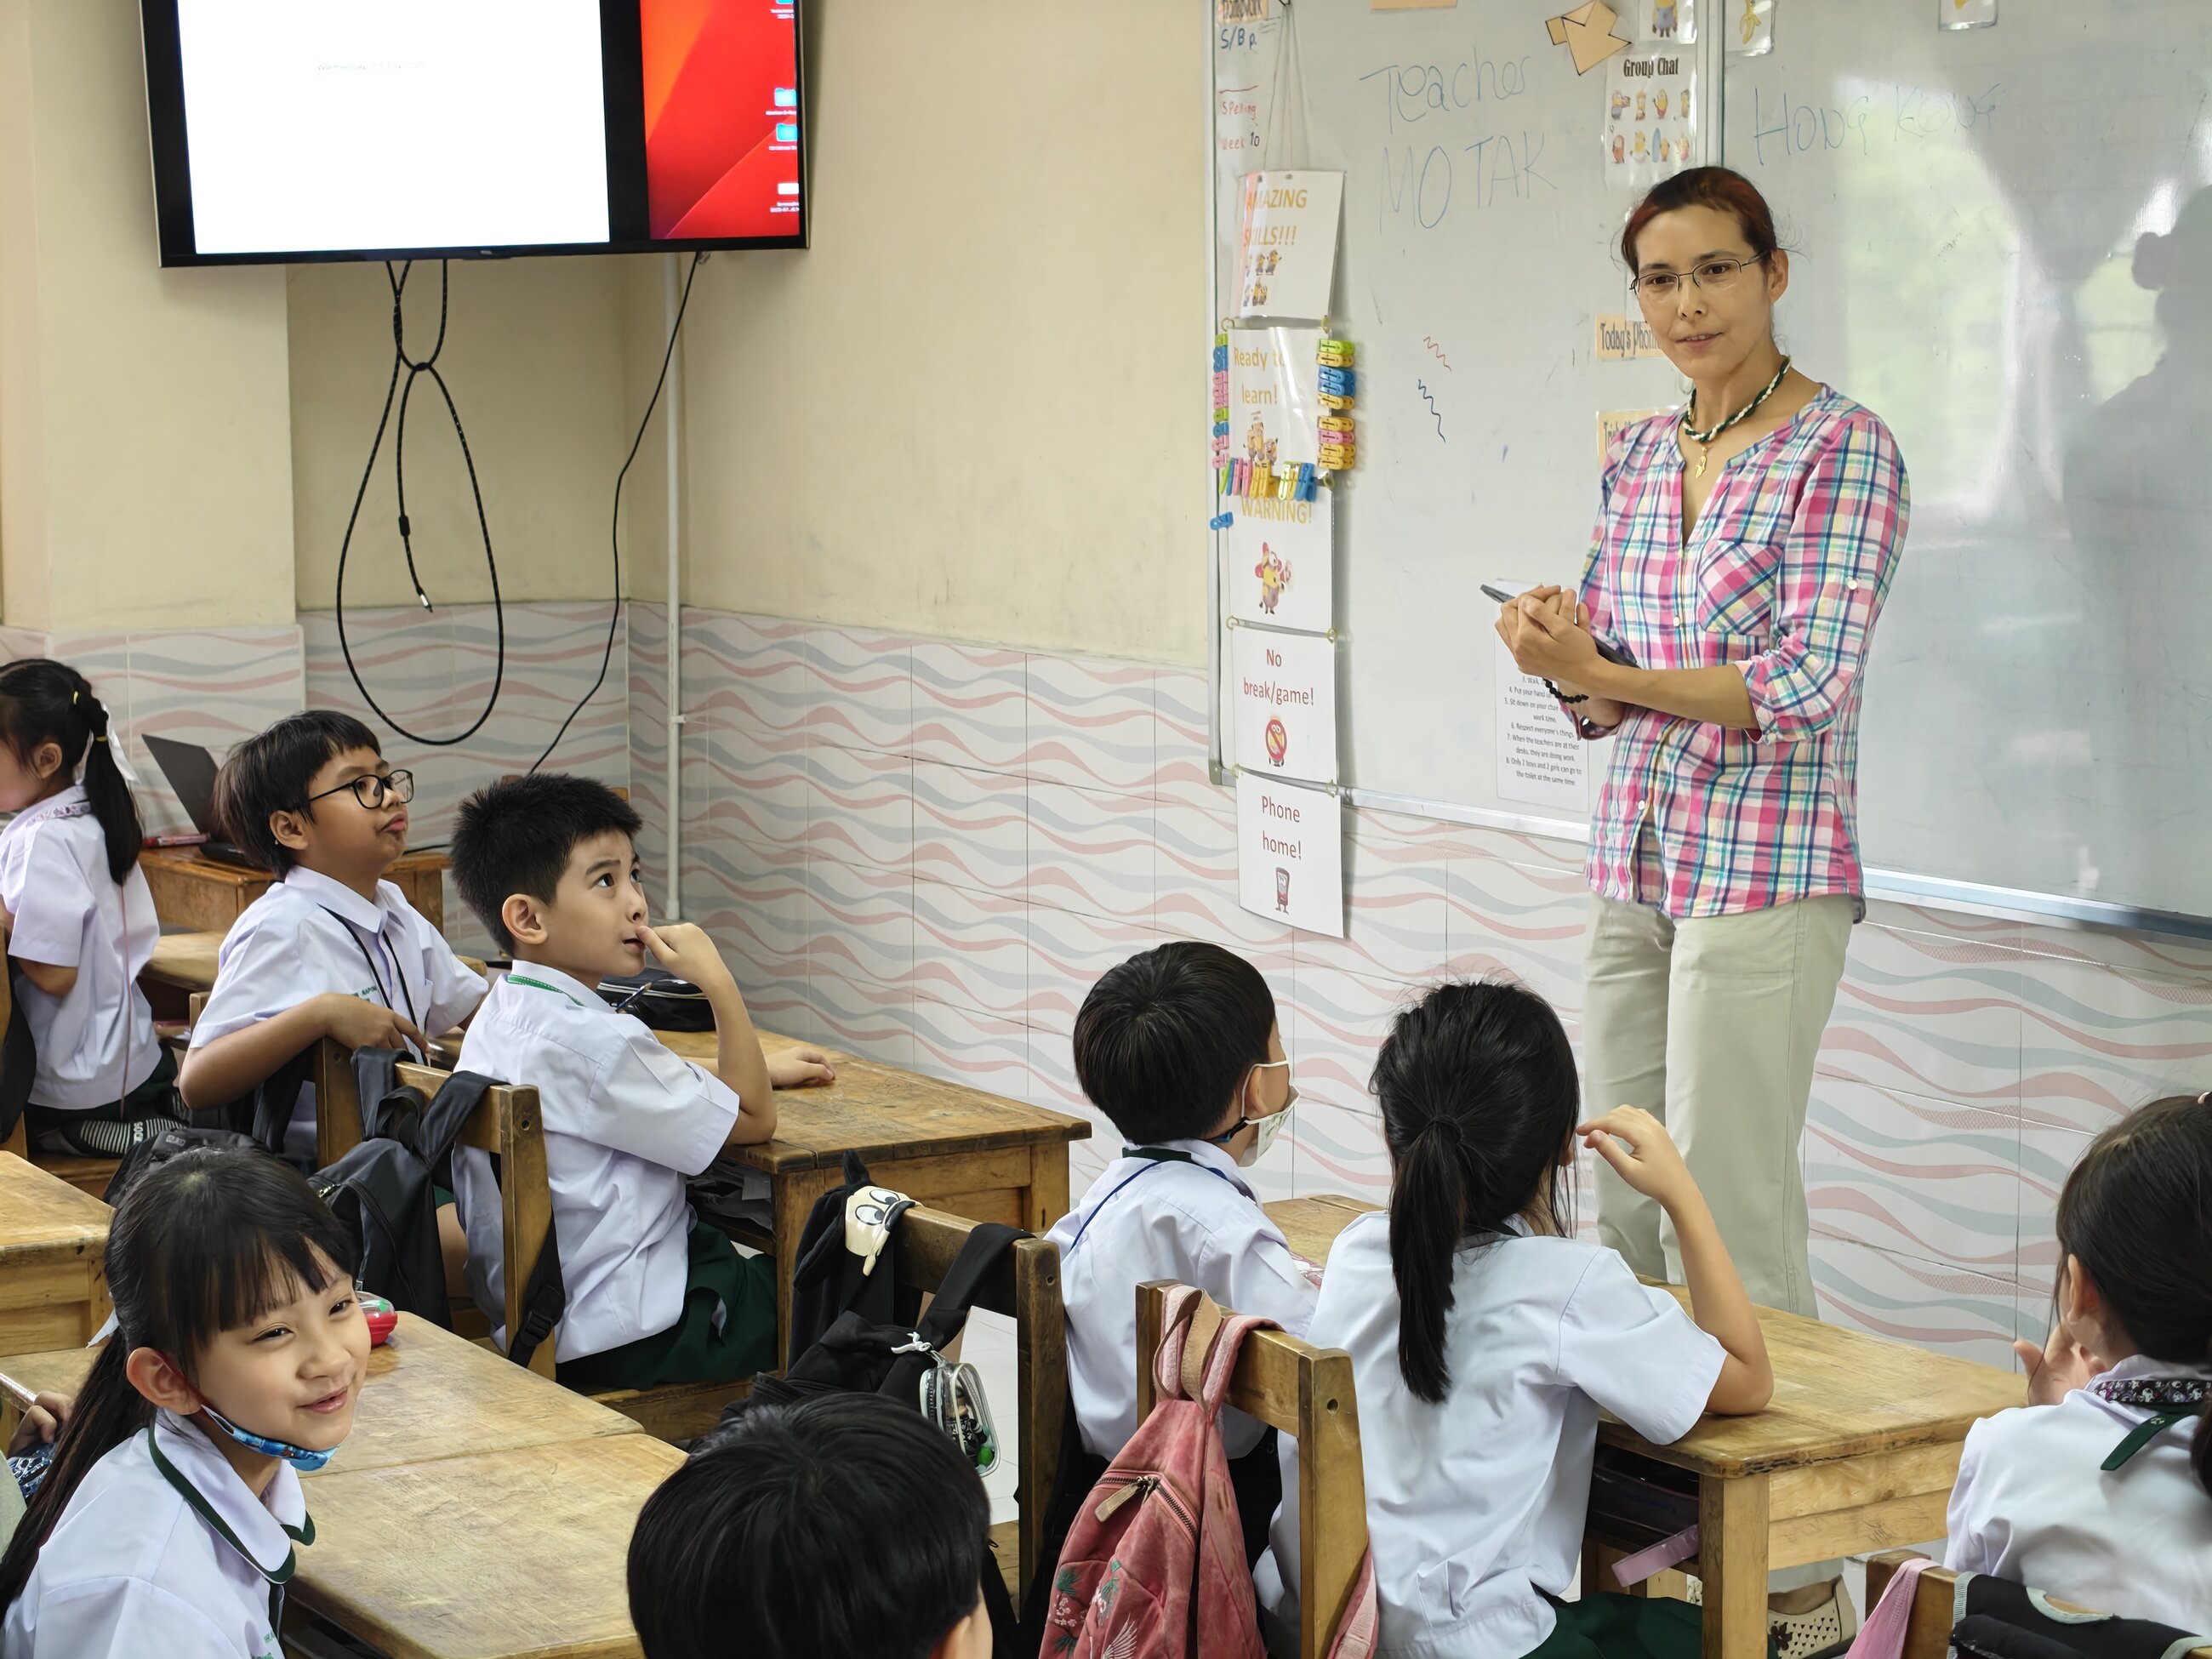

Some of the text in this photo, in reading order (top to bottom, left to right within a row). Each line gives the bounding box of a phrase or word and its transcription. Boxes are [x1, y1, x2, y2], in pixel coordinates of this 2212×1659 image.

[1623, 57, 1679, 78] Group Chat
[1234, 347, 1268, 372] Ready
[1241, 385, 1278, 405] learn!
[1241, 499, 1313, 524] WARNING!
[1266, 649, 1282, 667] No
[1244, 676, 1314, 706] break/game!
[1262, 795, 1301, 823] Phone
[1263, 830, 1302, 860] home!
